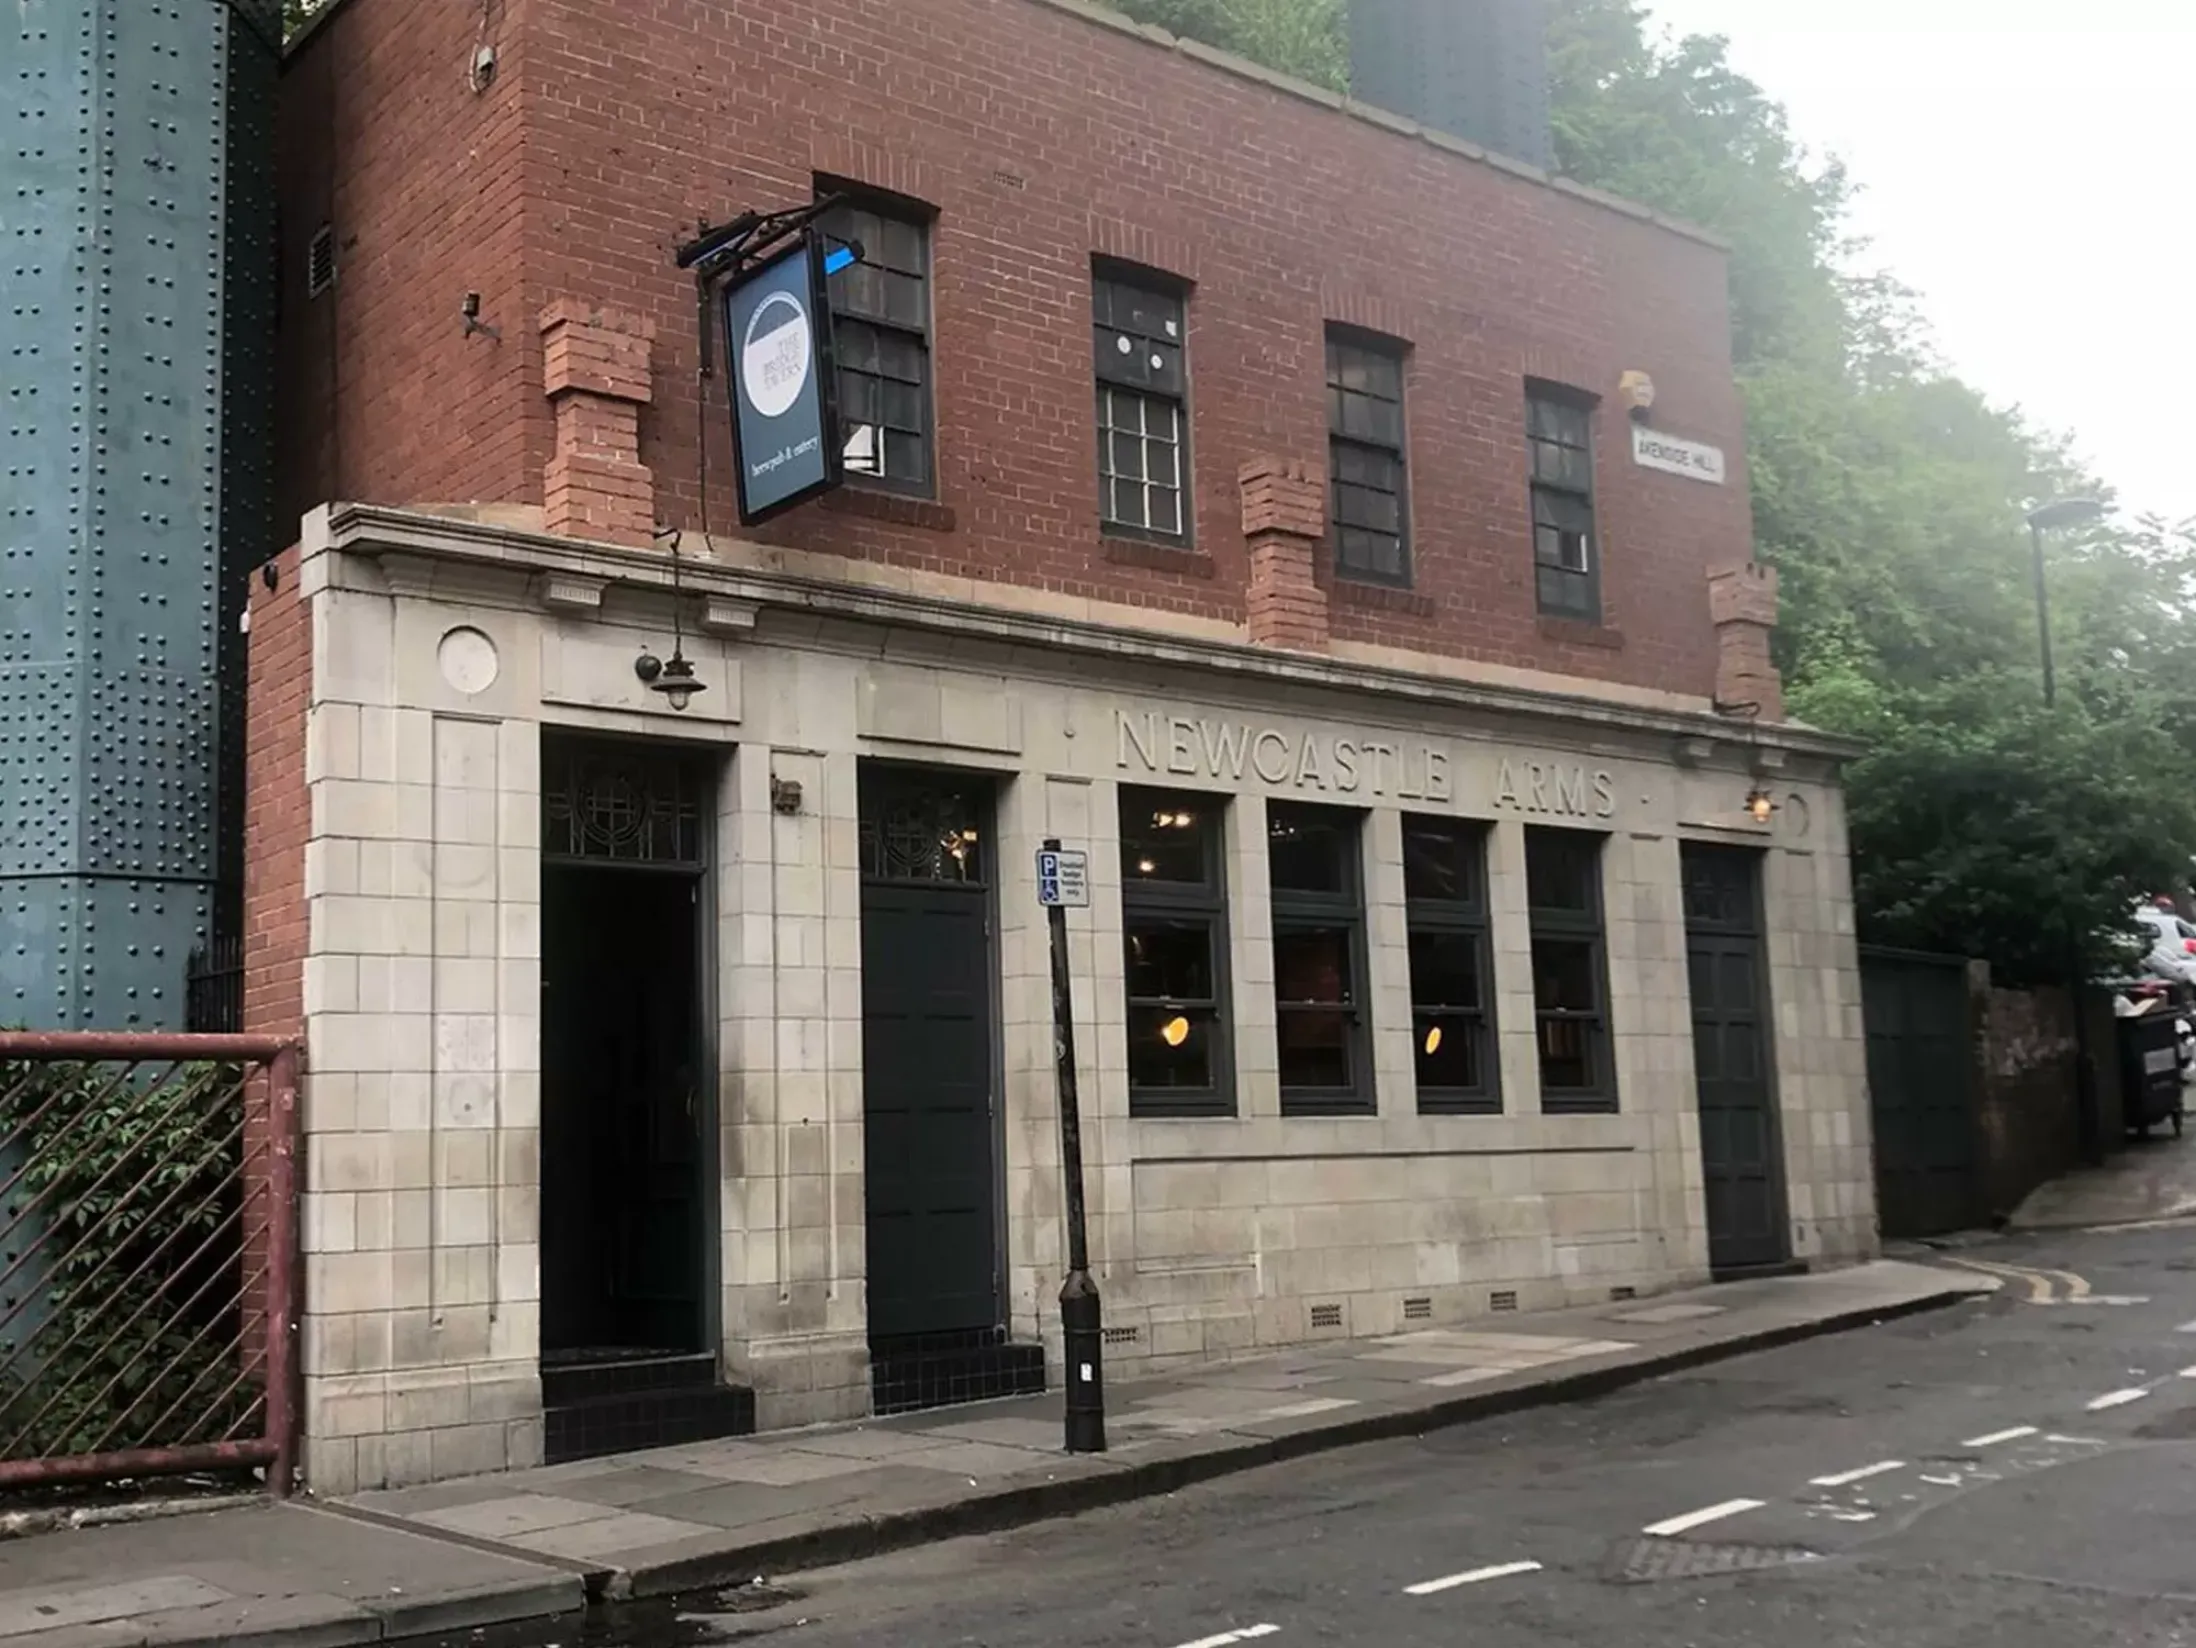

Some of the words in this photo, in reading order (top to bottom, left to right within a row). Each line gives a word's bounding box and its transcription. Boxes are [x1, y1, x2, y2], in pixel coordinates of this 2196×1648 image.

[1113, 709, 1452, 803] NEWCASTLE
[1493, 757, 1617, 819] ARMS
[1044, 857, 1054, 875] P
